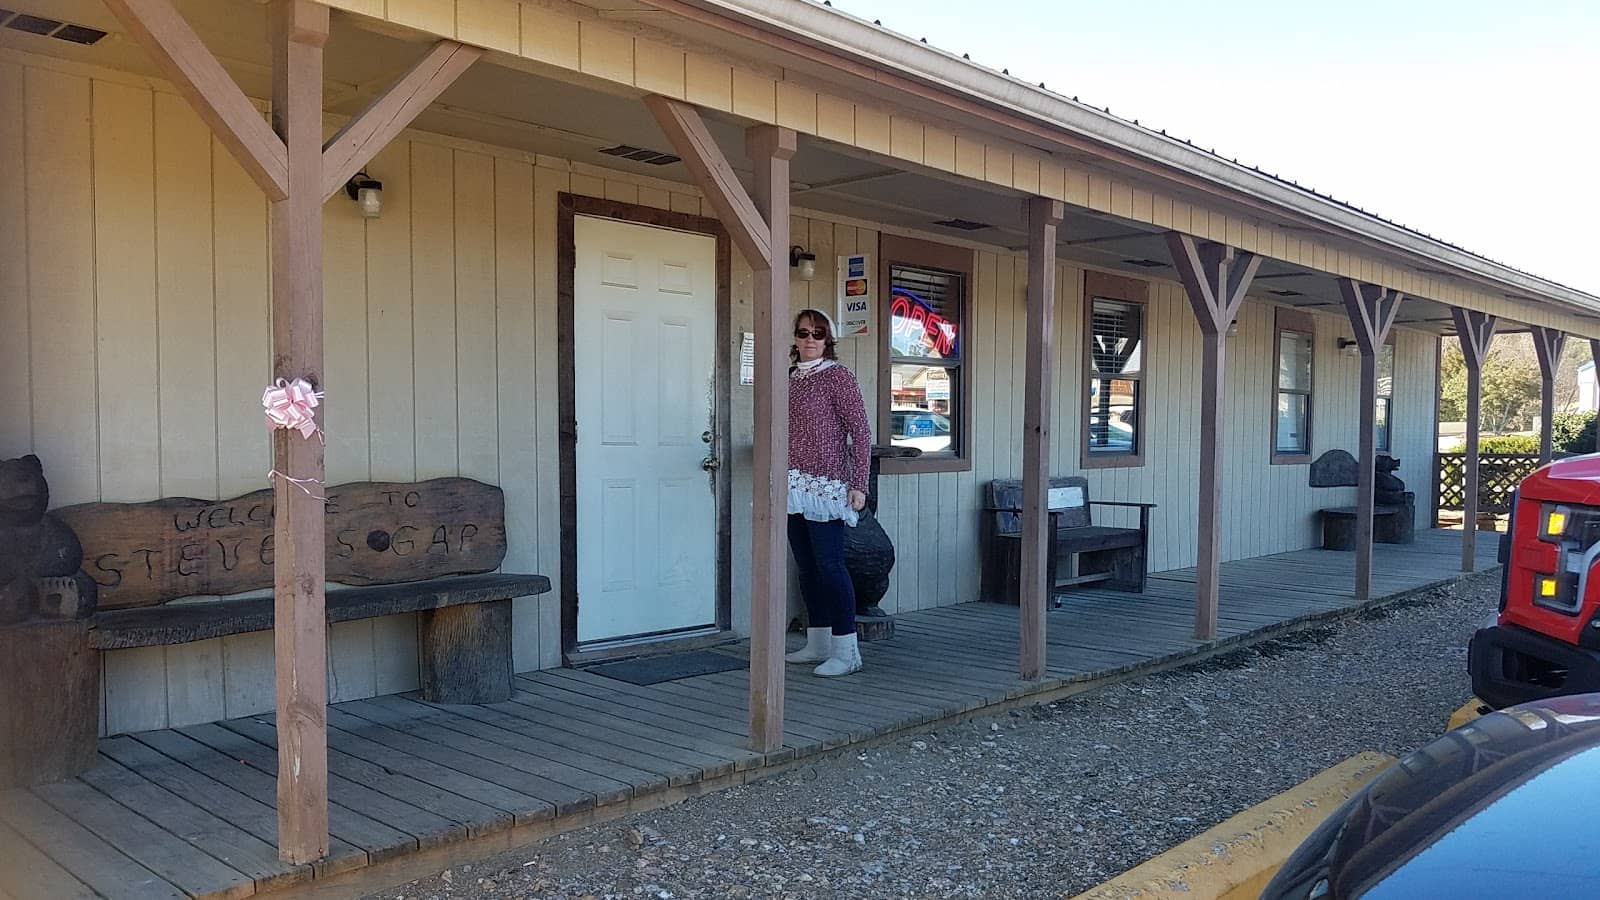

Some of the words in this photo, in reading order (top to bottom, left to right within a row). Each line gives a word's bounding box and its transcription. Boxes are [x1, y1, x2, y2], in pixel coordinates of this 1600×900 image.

[846, 301, 867, 313] VISA
[891, 296, 958, 356] OPEN
[174, 494, 339, 532] WELCE
[381, 490, 421, 508] TO
[391, 524, 478, 557] GAP
